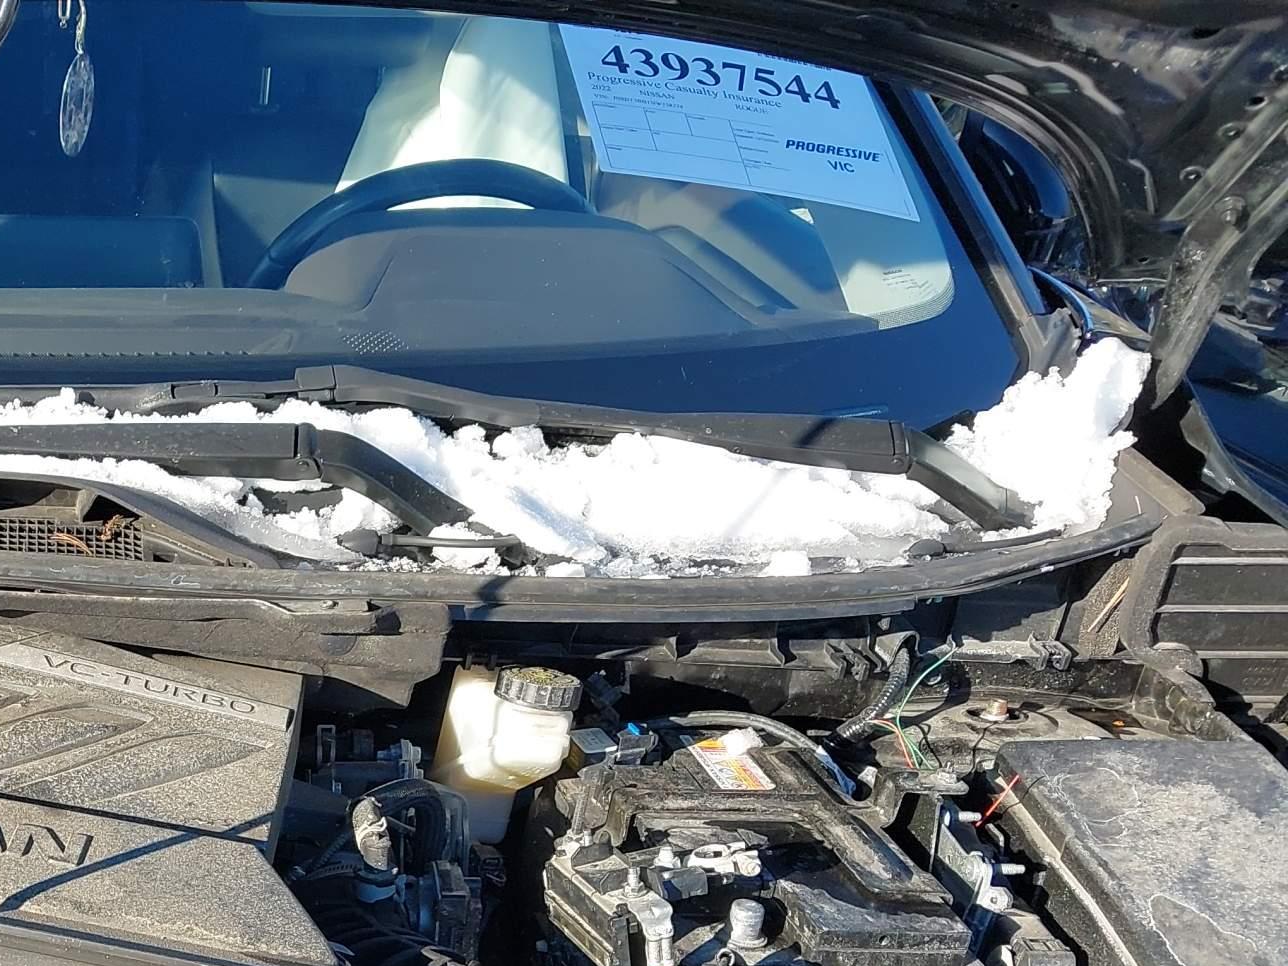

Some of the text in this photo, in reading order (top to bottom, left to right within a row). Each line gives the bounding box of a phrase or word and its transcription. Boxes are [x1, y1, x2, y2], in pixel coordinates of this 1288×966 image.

[587, 71, 783, 108] Progressive Casualty Insurance
[601, 45, 841, 110] 43937544
[591, 84, 769, 115] 2022 NISSAN ROGUE
[785, 139, 881, 162] PROGRESSIVE
[827, 159, 855, 173] VIC
[42, 653, 258, 714] VC-TURBO
